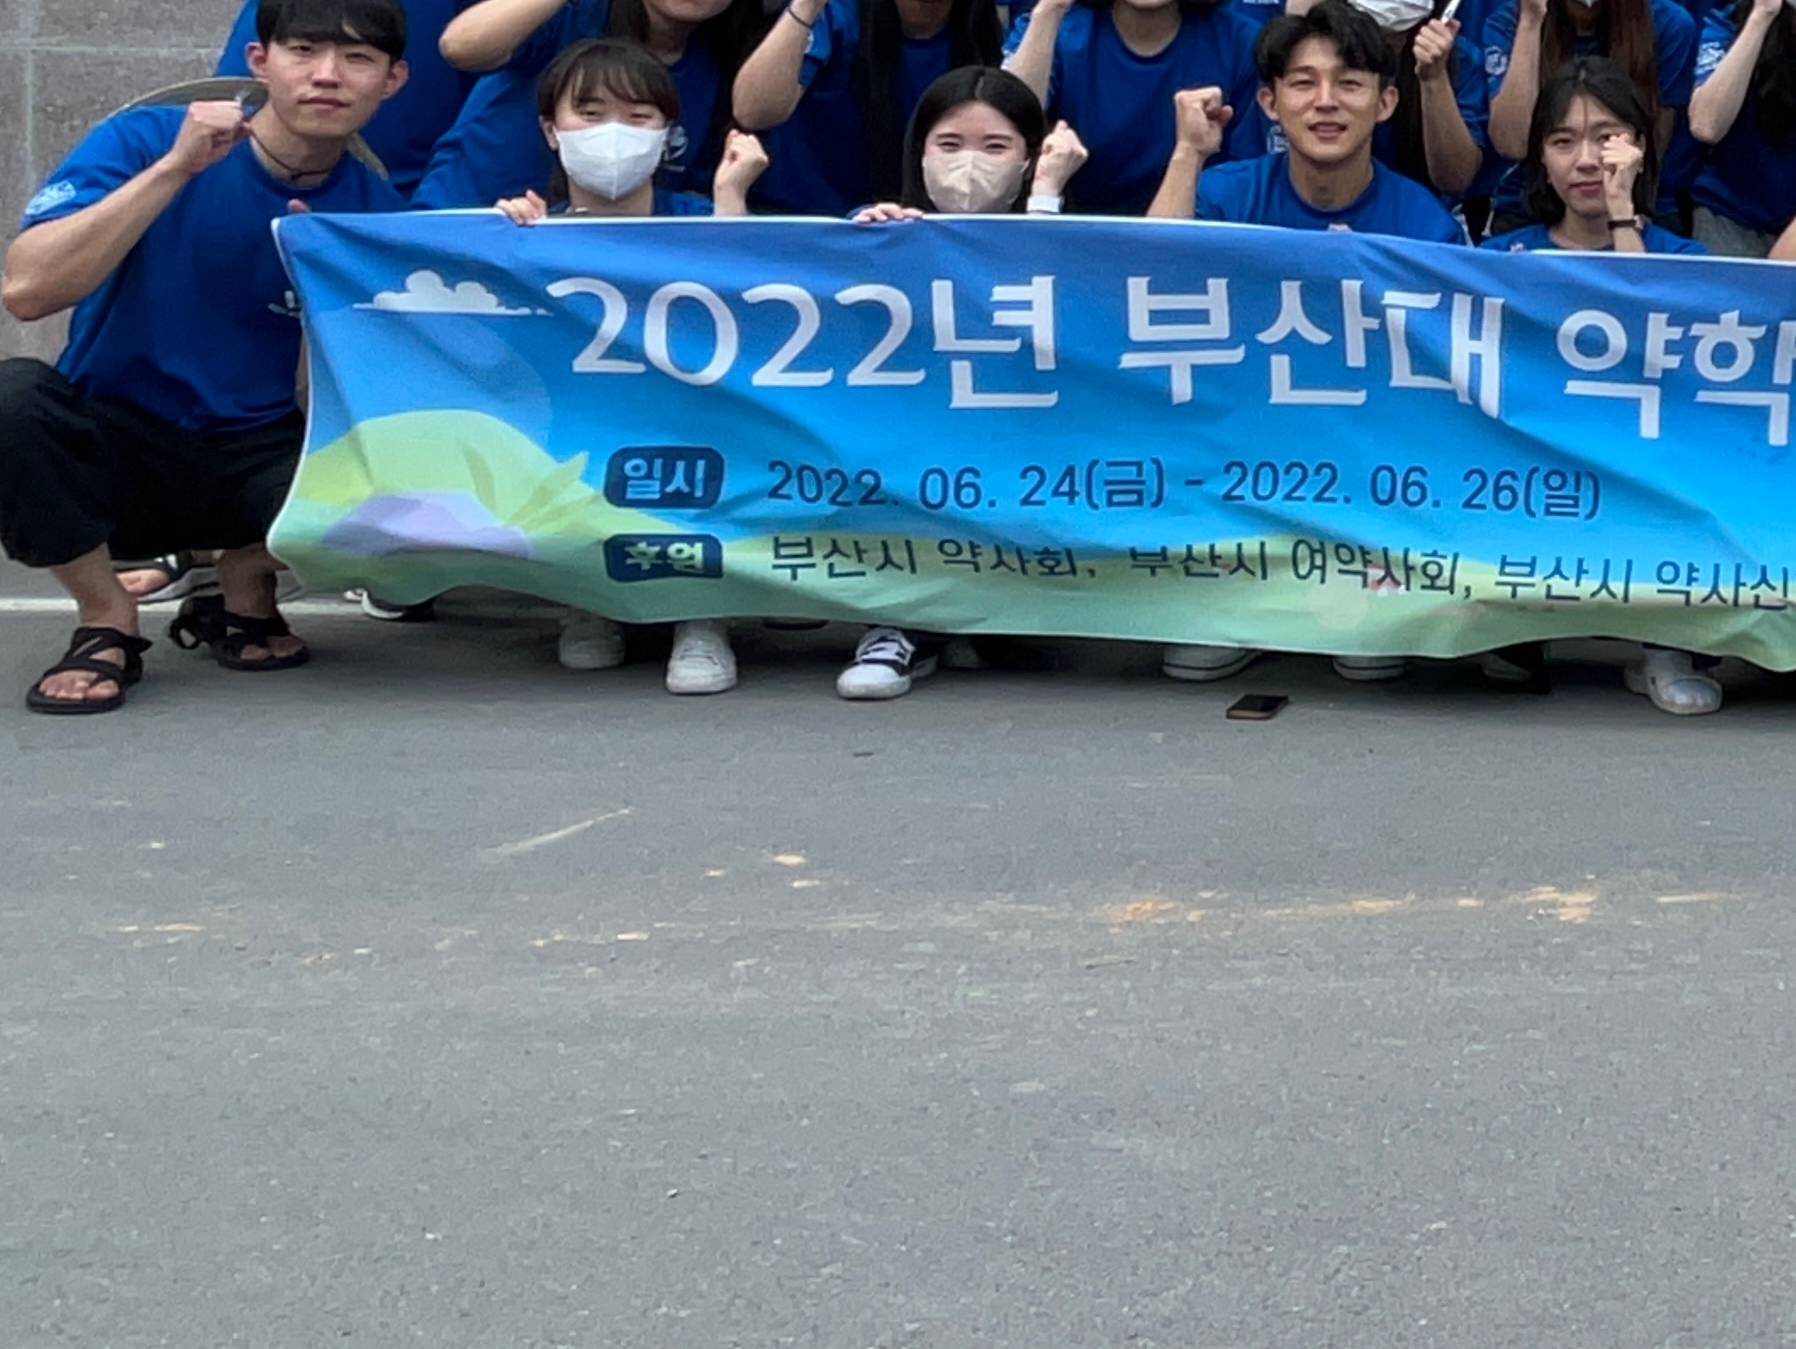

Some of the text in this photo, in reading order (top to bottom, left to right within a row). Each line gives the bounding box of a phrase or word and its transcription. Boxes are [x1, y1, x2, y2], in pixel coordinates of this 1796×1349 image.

[545, 274, 1059, 410] 2022년
[1119, 276, 1506, 419] 부산대
[624, 458, 706, 499] 일시
[767, 460, 898, 508] 2022.
[917, 467, 999, 510] 06.
[1018, 457, 1166, 510] 24(금)
[1221, 459, 1352, 507] 2022.
[1369, 465, 1443, 509] 06.
[1462, 466, 1602, 520] 26(일)
[771, 536, 918, 581] 부산시
[937, 538, 1097, 579] 약사회,
[1127, 546, 1268, 581] 부산시
[1290, 538, 1472, 601] 여약사회,
[1494, 555, 1632, 604] 부산시
